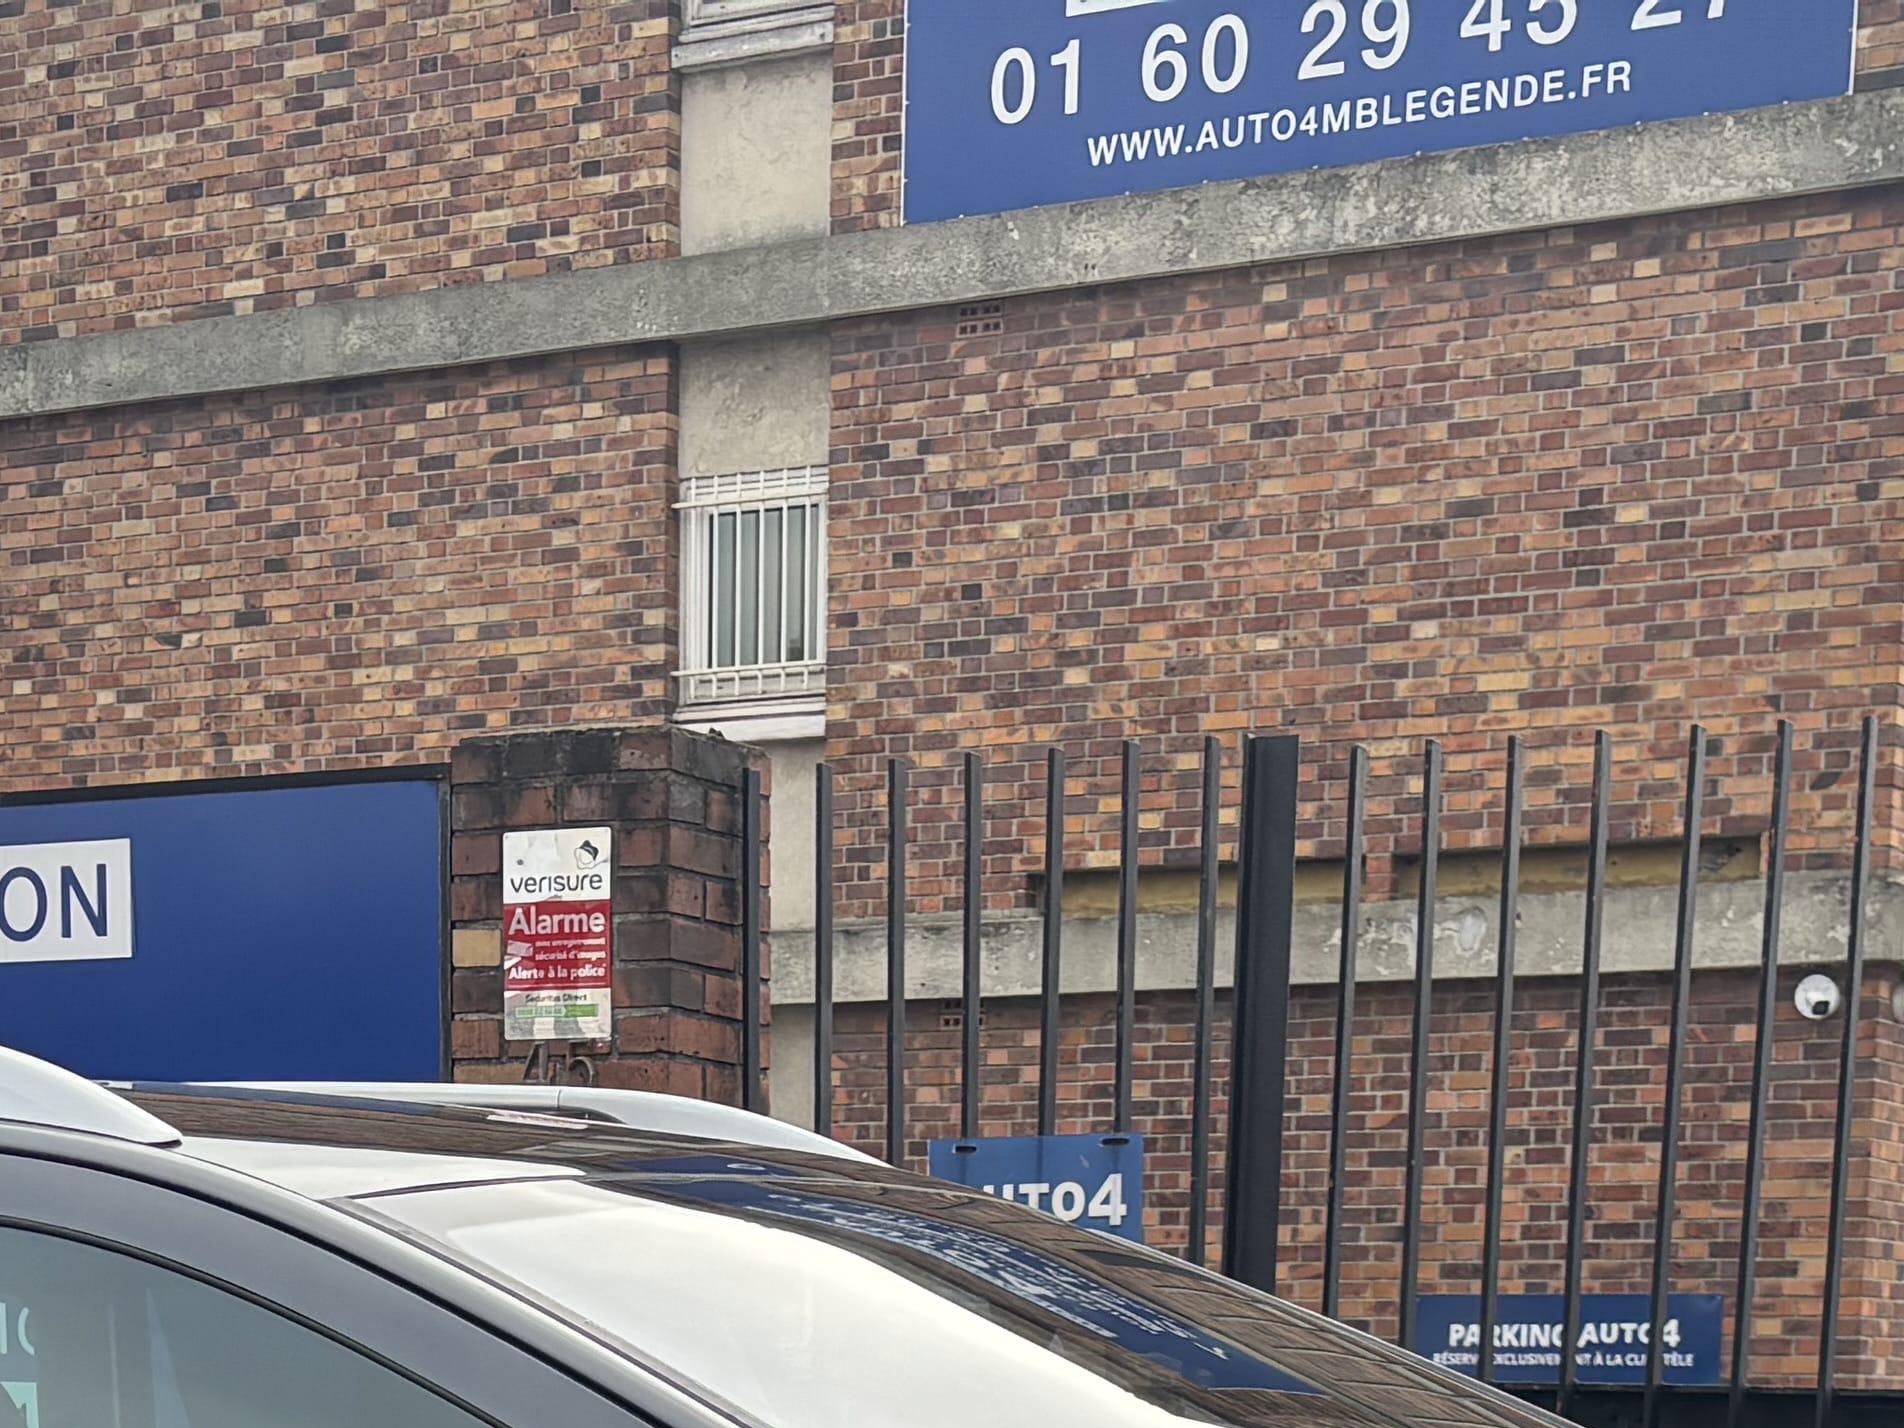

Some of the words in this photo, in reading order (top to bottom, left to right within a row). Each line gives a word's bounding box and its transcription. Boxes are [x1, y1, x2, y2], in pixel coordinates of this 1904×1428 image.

[991, 39, 1080, 124] 01
[1141, 14, 1249, 102] 60
[1297, 0, 1410, 80] 29
[1460, 0, 1577, 52] 45
[1087, 60, 1631, 167] WWW.AUTO4MBLEGENDE.FR
[510, 873, 604, 893] verisure
[508, 905, 606, 936] Alarme
[508, 965, 545, 980] Alerte
[557, 965, 568, 978] la
[982, 1172, 1129, 1227] TO4
[1432, 1350, 1483, 1365] RÉSERV
